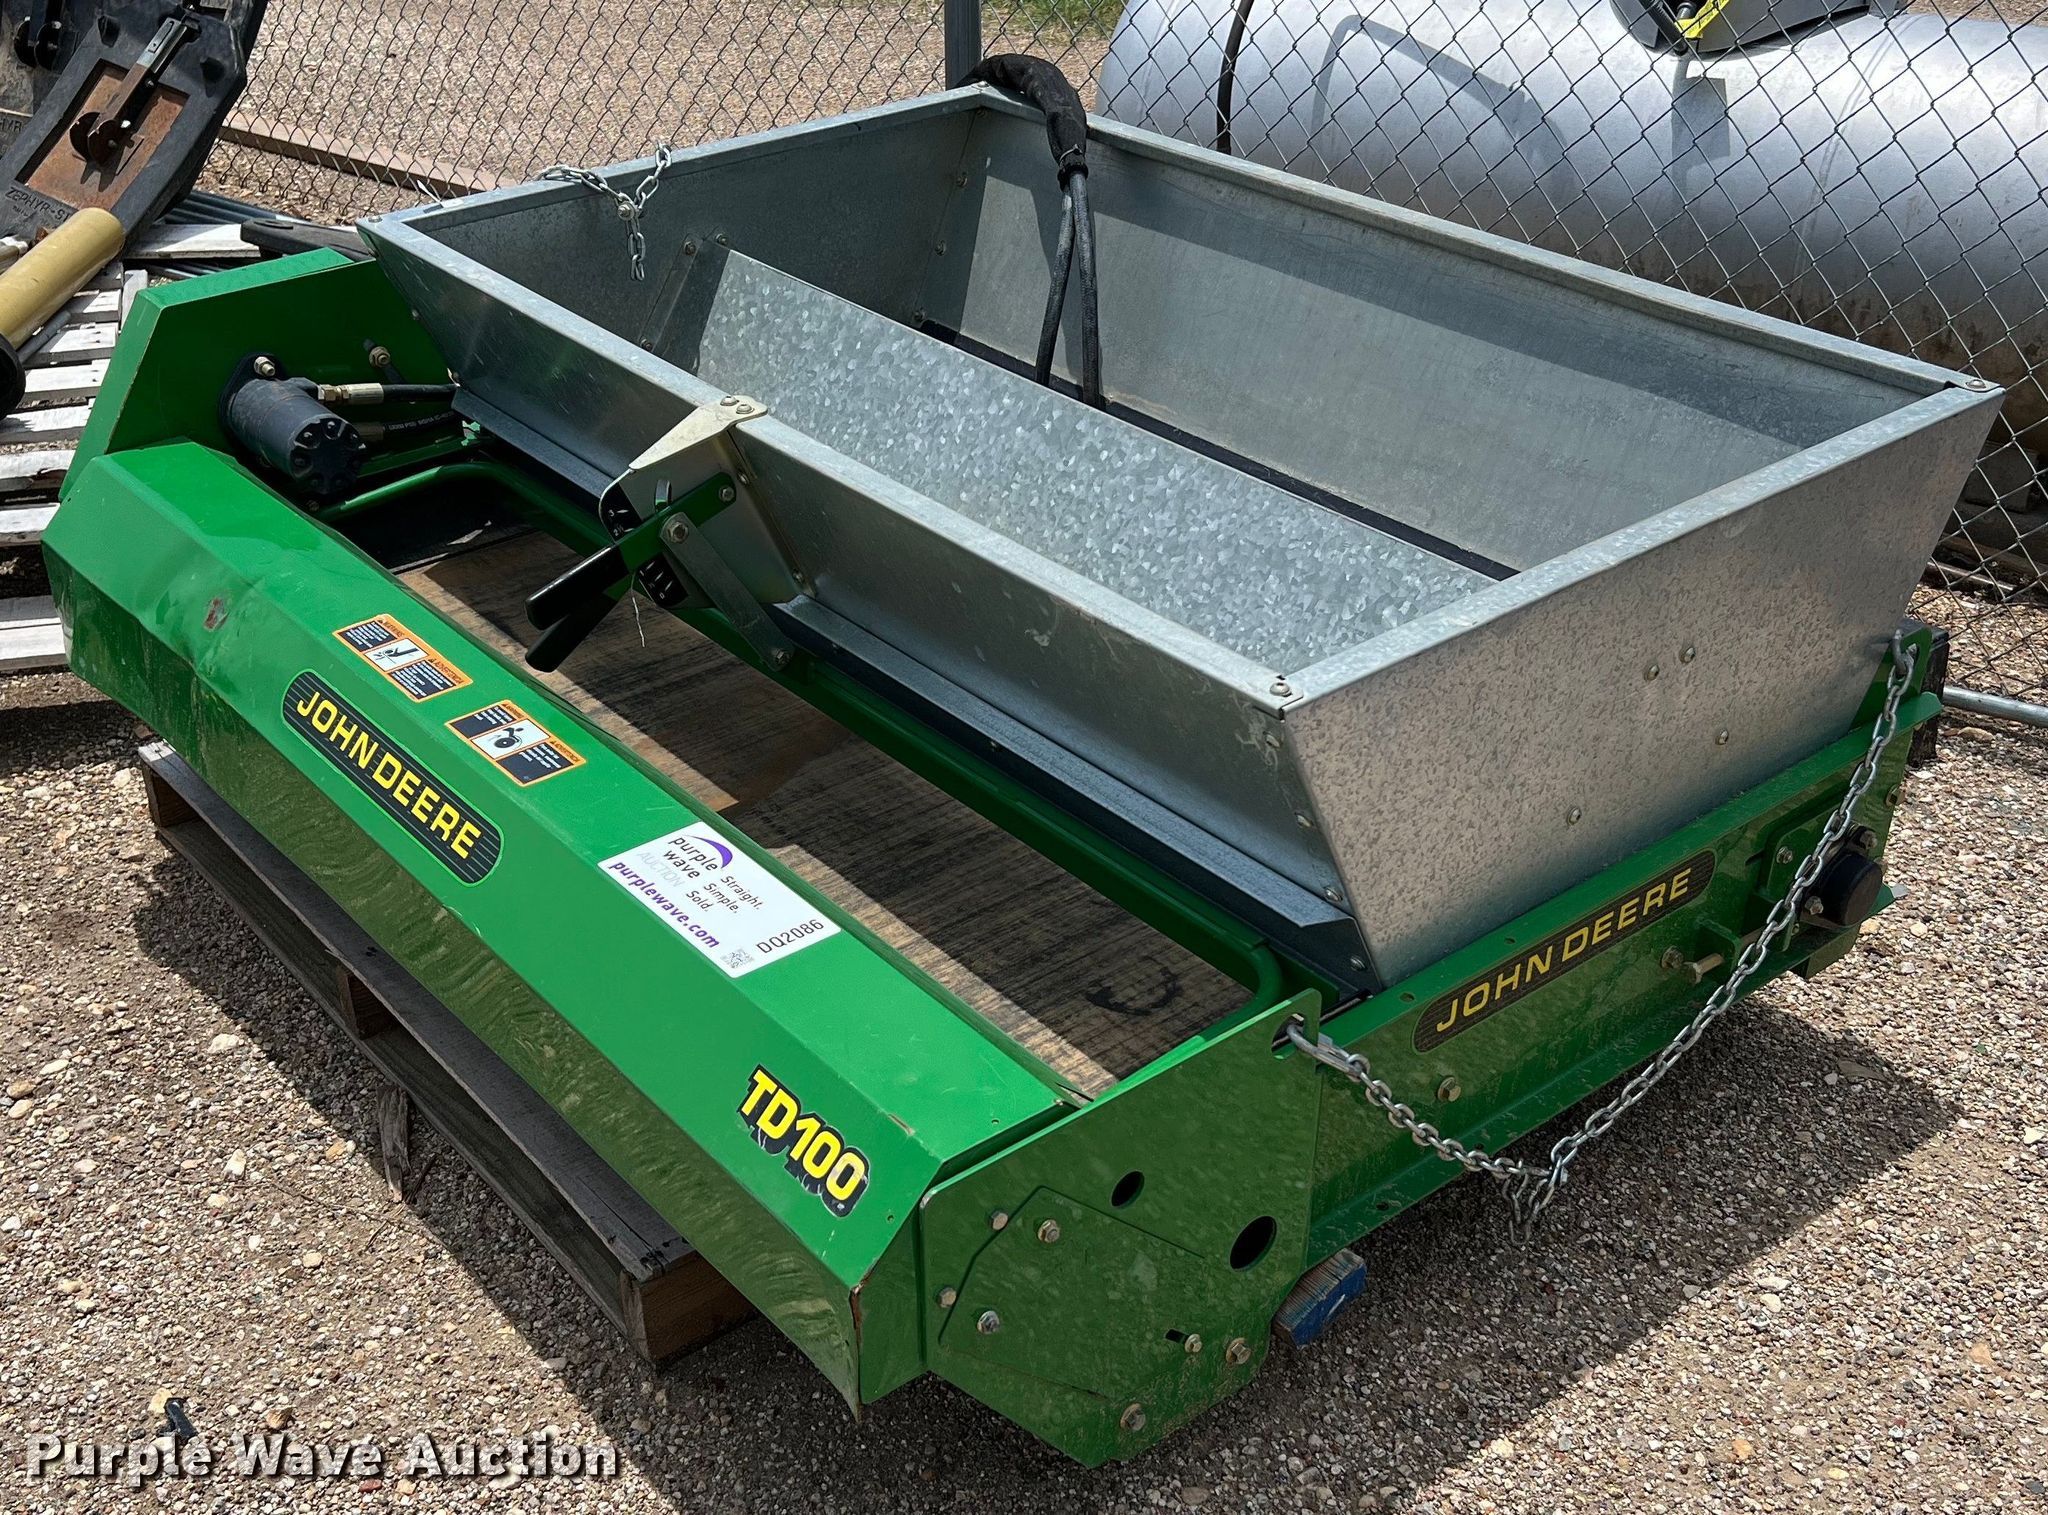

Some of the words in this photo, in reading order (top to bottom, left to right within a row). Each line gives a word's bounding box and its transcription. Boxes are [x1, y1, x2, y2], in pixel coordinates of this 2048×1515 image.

[296, 691, 381, 771] JOHN
[372, 751, 483, 860] DEERE
[662, 849, 701, 880] wave
[668, 836, 719, 872] purple
[608, 860, 721, 949] purplewave.com
[685, 890, 711, 912] Sold.
[703, 882, 739, 914] Simple.
[720, 875, 763, 910] Straight.
[756, 918, 825, 954] DQ2086
[1436, 945, 1554, 1033] JOHN
[1562, 867, 1692, 963] DEERE
[741, 1069, 866, 1201] TD100
